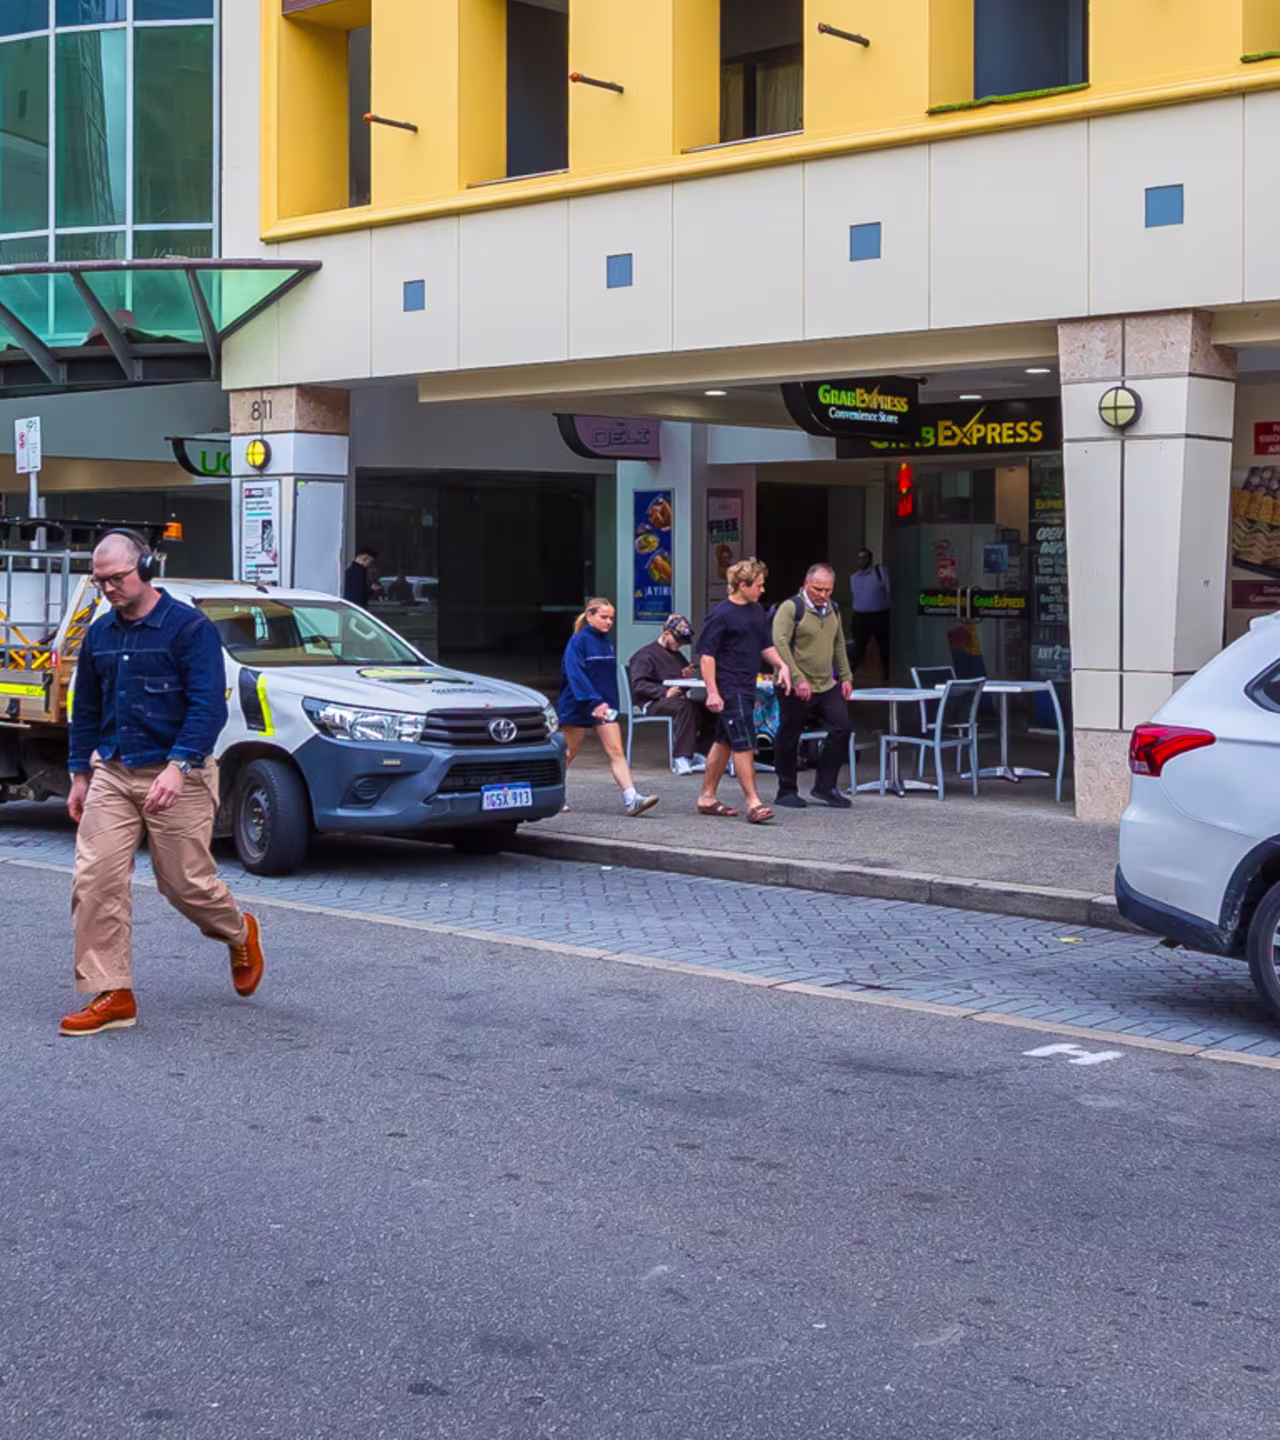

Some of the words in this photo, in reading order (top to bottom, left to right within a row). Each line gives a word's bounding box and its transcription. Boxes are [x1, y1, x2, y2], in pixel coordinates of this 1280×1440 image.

[250, 400, 273, 421] 811
[828, 407, 878, 422] Convenience
[878, 413, 899, 424] Store
[707, 518, 739, 533] FREE
